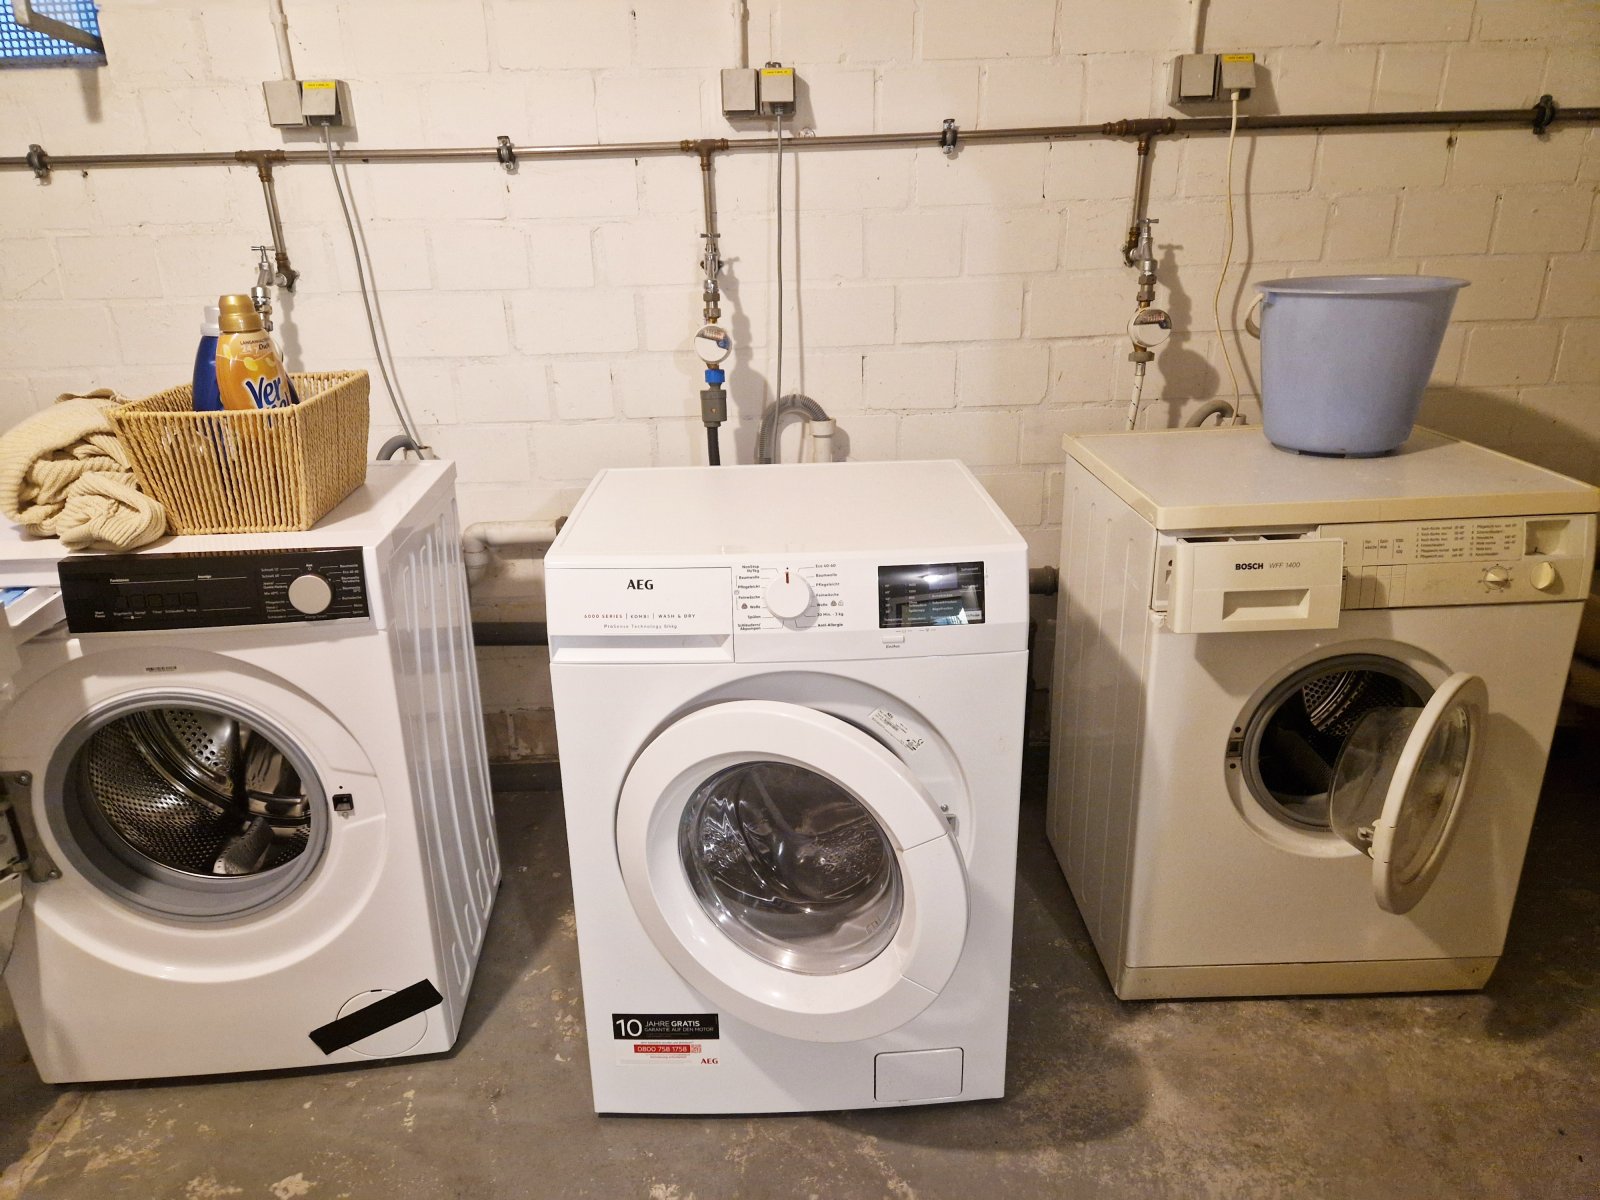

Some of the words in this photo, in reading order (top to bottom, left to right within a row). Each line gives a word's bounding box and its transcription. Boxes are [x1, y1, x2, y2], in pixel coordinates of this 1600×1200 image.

[245, 376, 281, 409] Ver
[1235, 562, 1264, 570] BOSCH
[626, 579, 654, 590] AEG
[615, 1018, 643, 1037] 10
[672, 1045, 688, 1053] 1758
